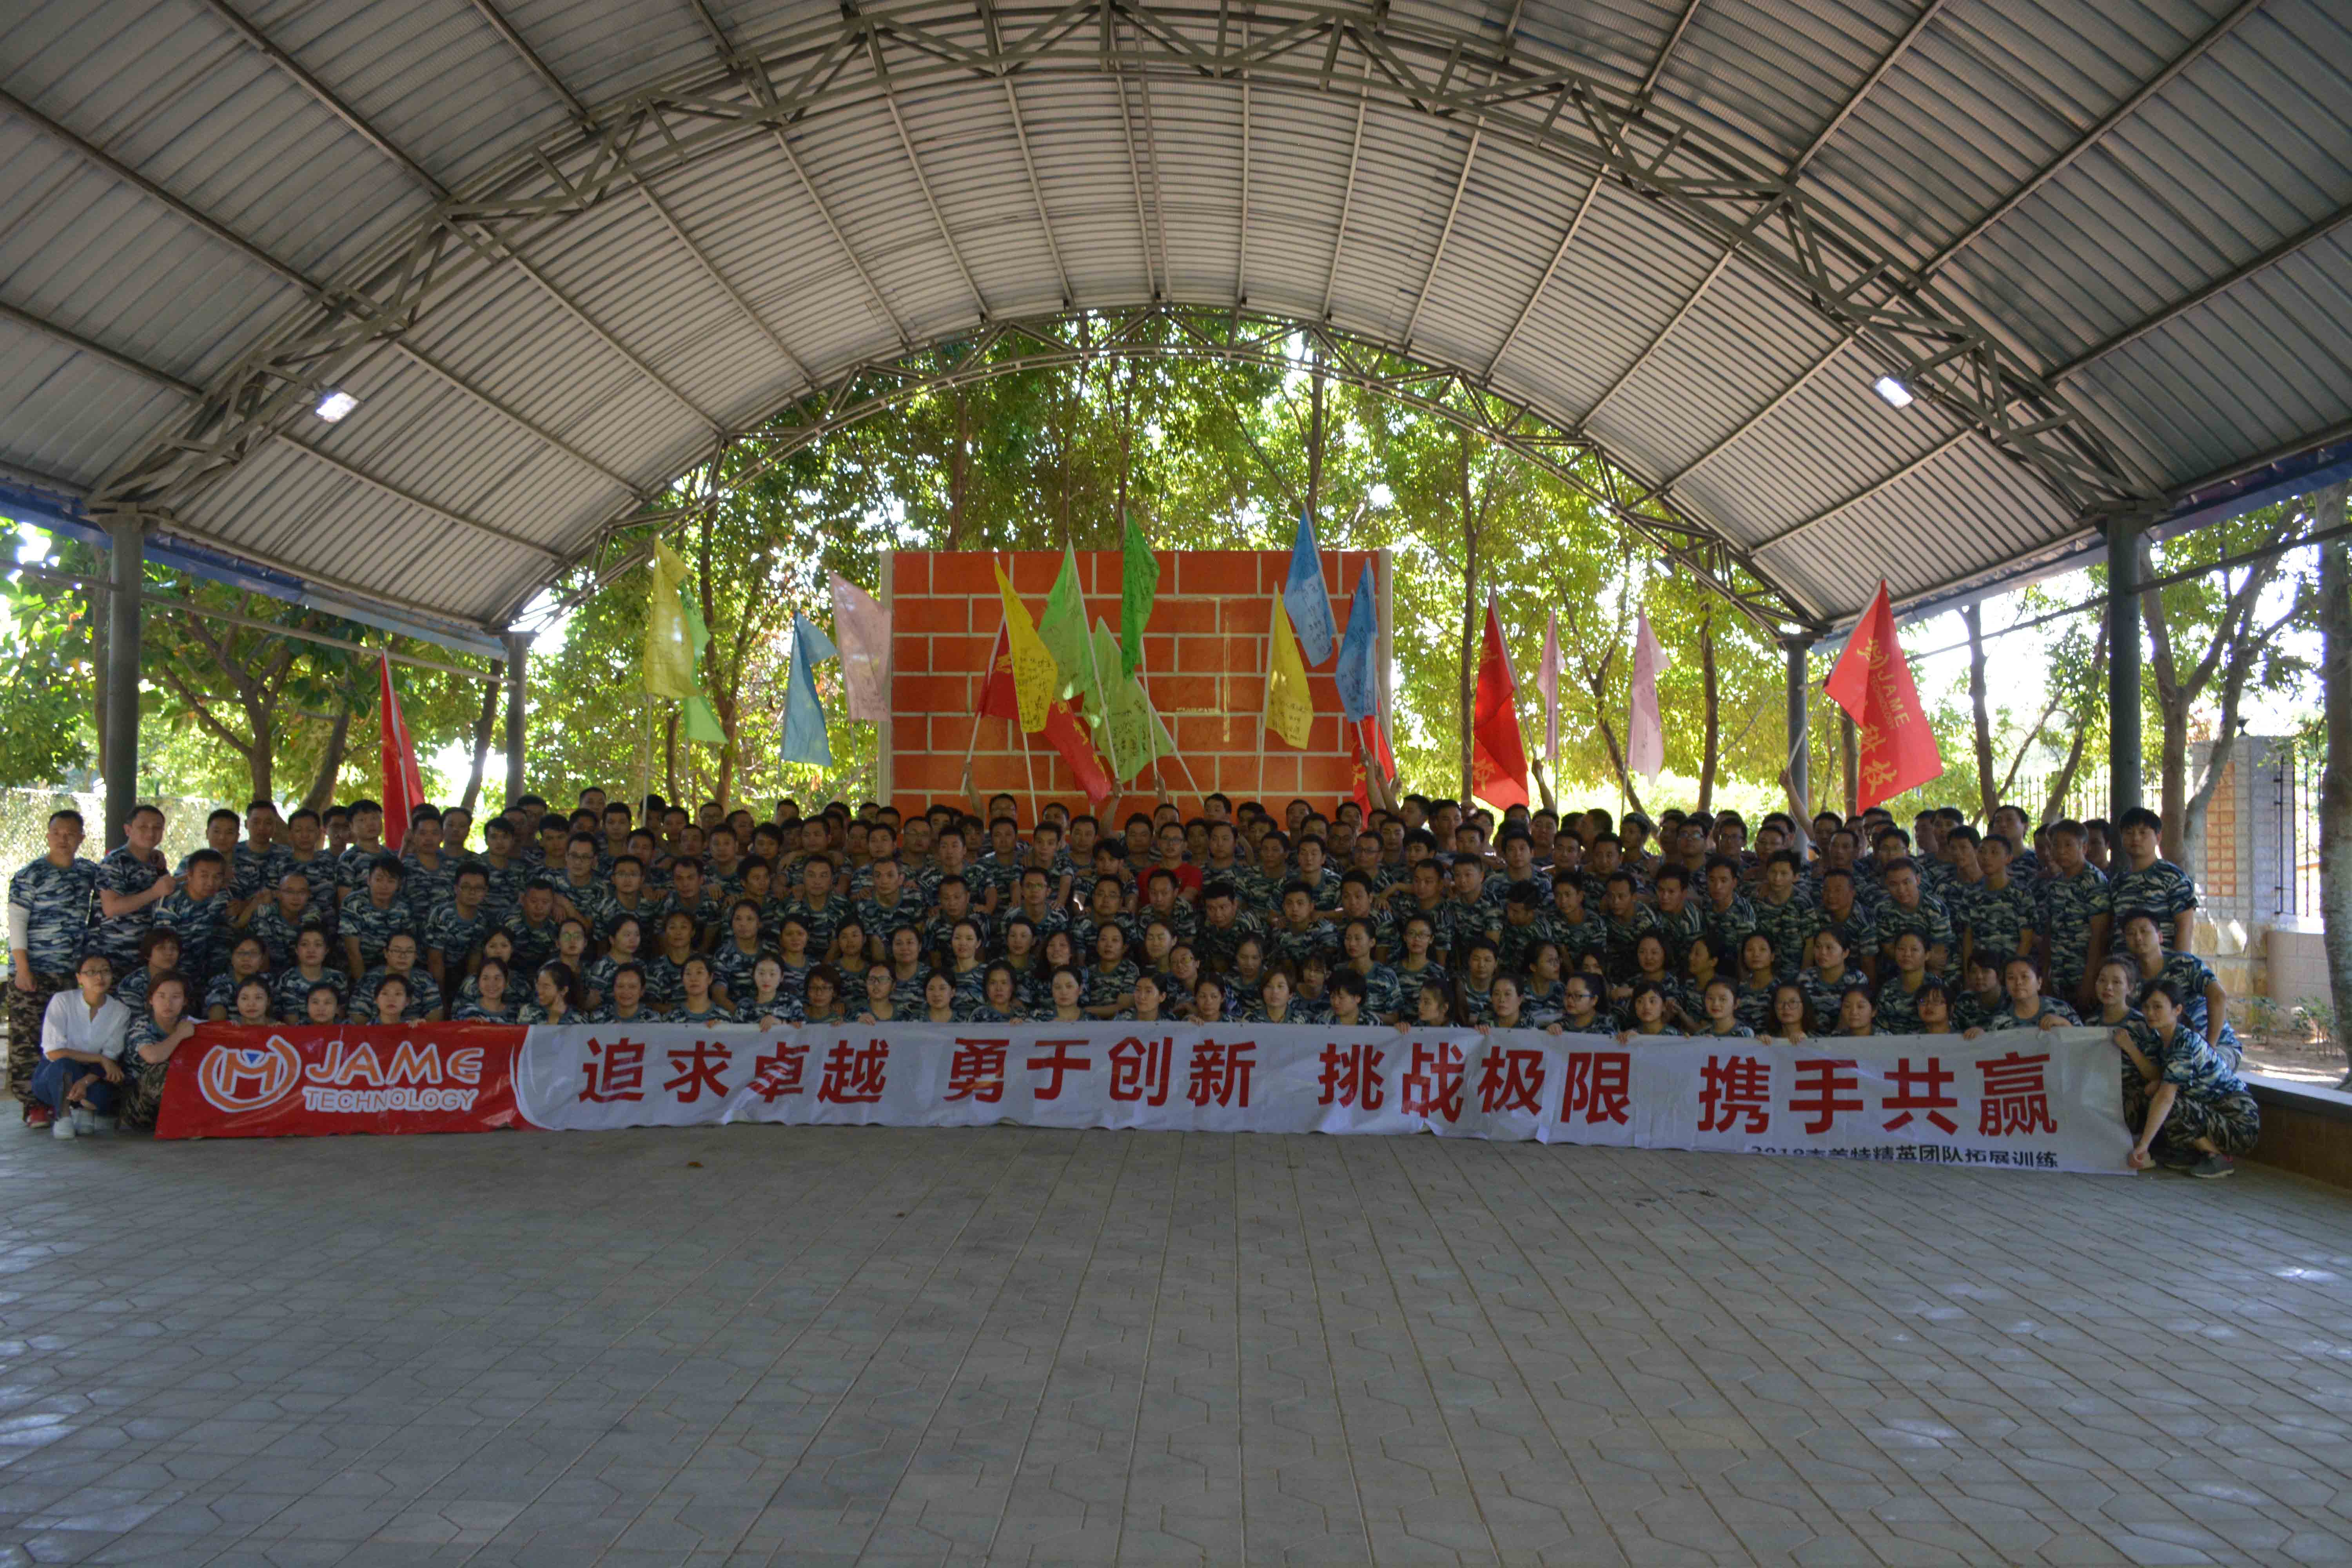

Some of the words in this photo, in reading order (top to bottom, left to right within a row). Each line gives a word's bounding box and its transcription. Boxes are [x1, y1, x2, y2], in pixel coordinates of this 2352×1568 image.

[1878, 671, 1910, 728] JAME
[305, 1041, 484, 1086] JAME
[579, 1037, 889, 1103] 追求卓越
[943, 1037, 1256, 1107] 勇于创新
[1318, 1042, 1631, 1125] 挑战极限
[1697, 1052, 2058, 1136] 携手共赢
[301, 1086, 479, 1112] TECHNOLOGY
